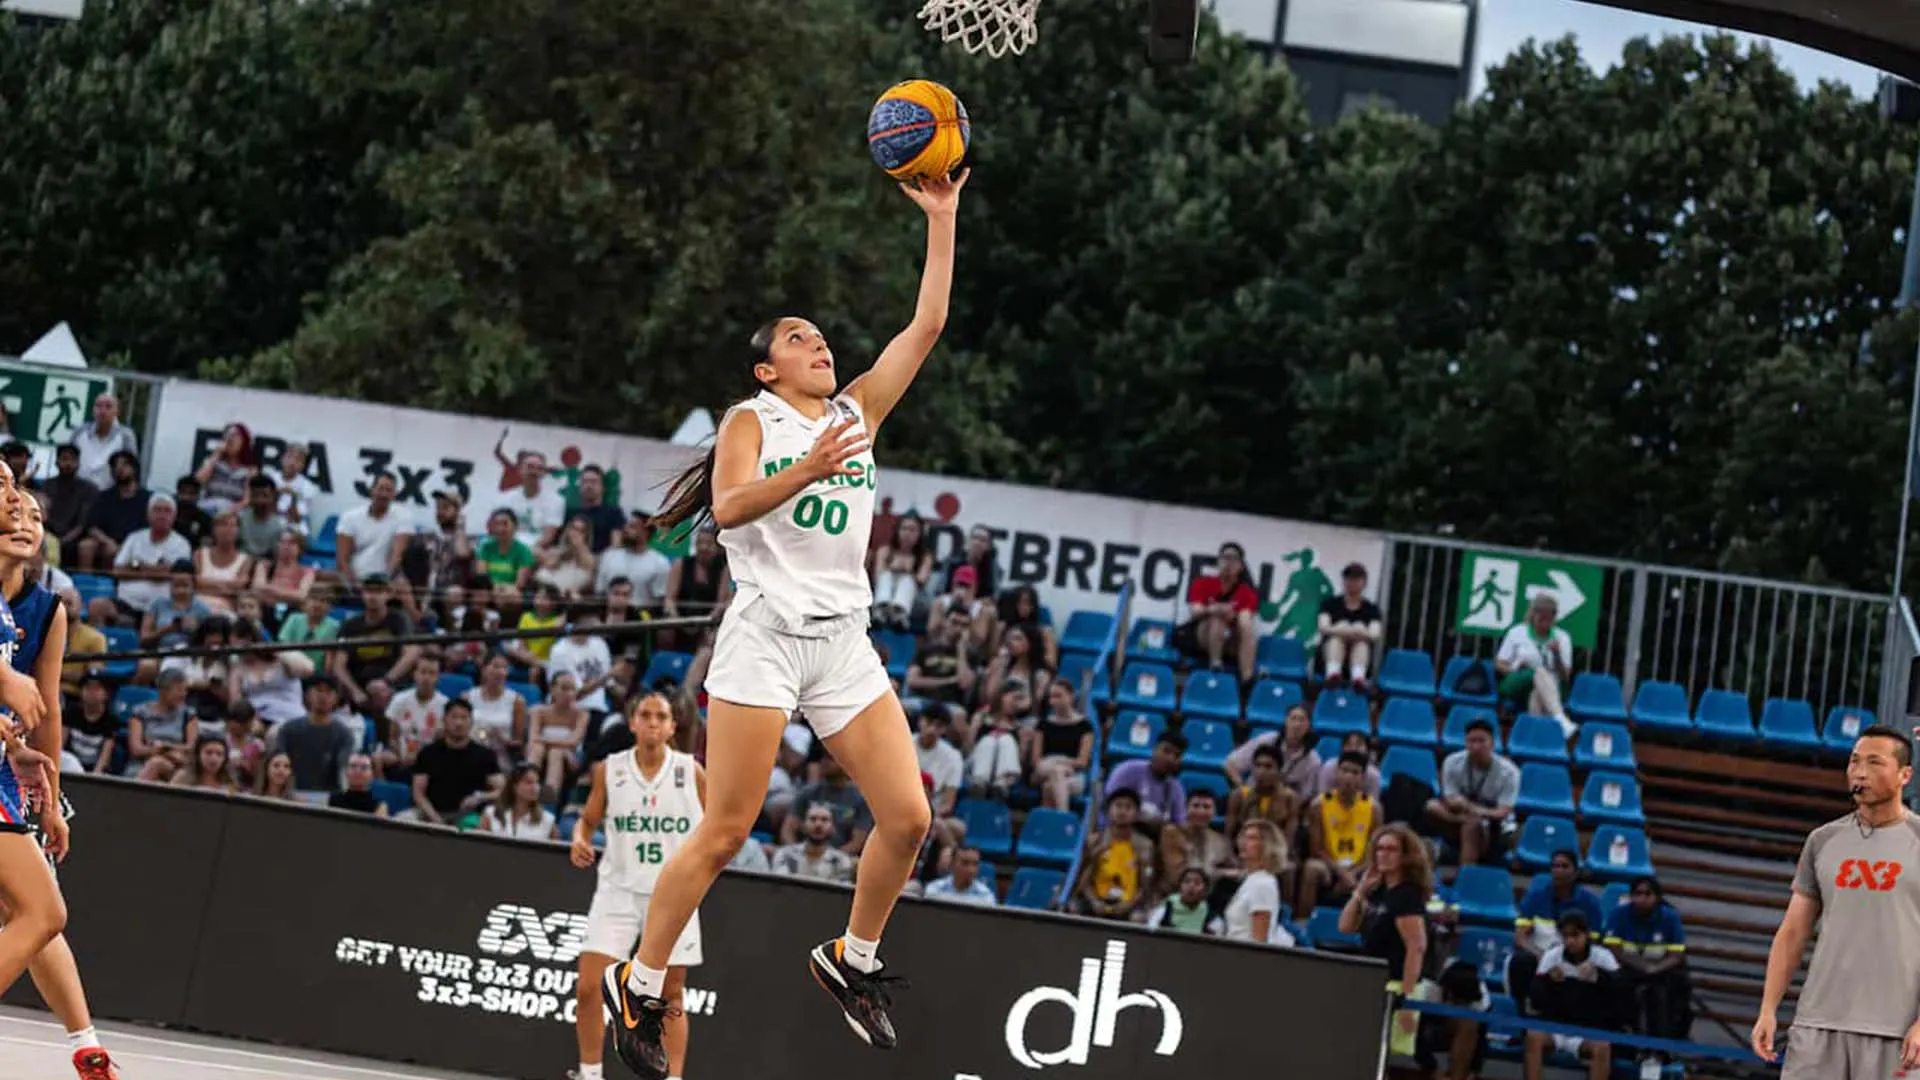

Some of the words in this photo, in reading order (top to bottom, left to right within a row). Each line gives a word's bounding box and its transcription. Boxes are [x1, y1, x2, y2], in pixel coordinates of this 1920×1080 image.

[793, 494, 849, 536] 00
[613, 810, 690, 834] MÉXICO
[635, 842, 663, 864] 15
[398, 946, 472, 980] YOUR
[476, 958, 530, 988] 3x3
